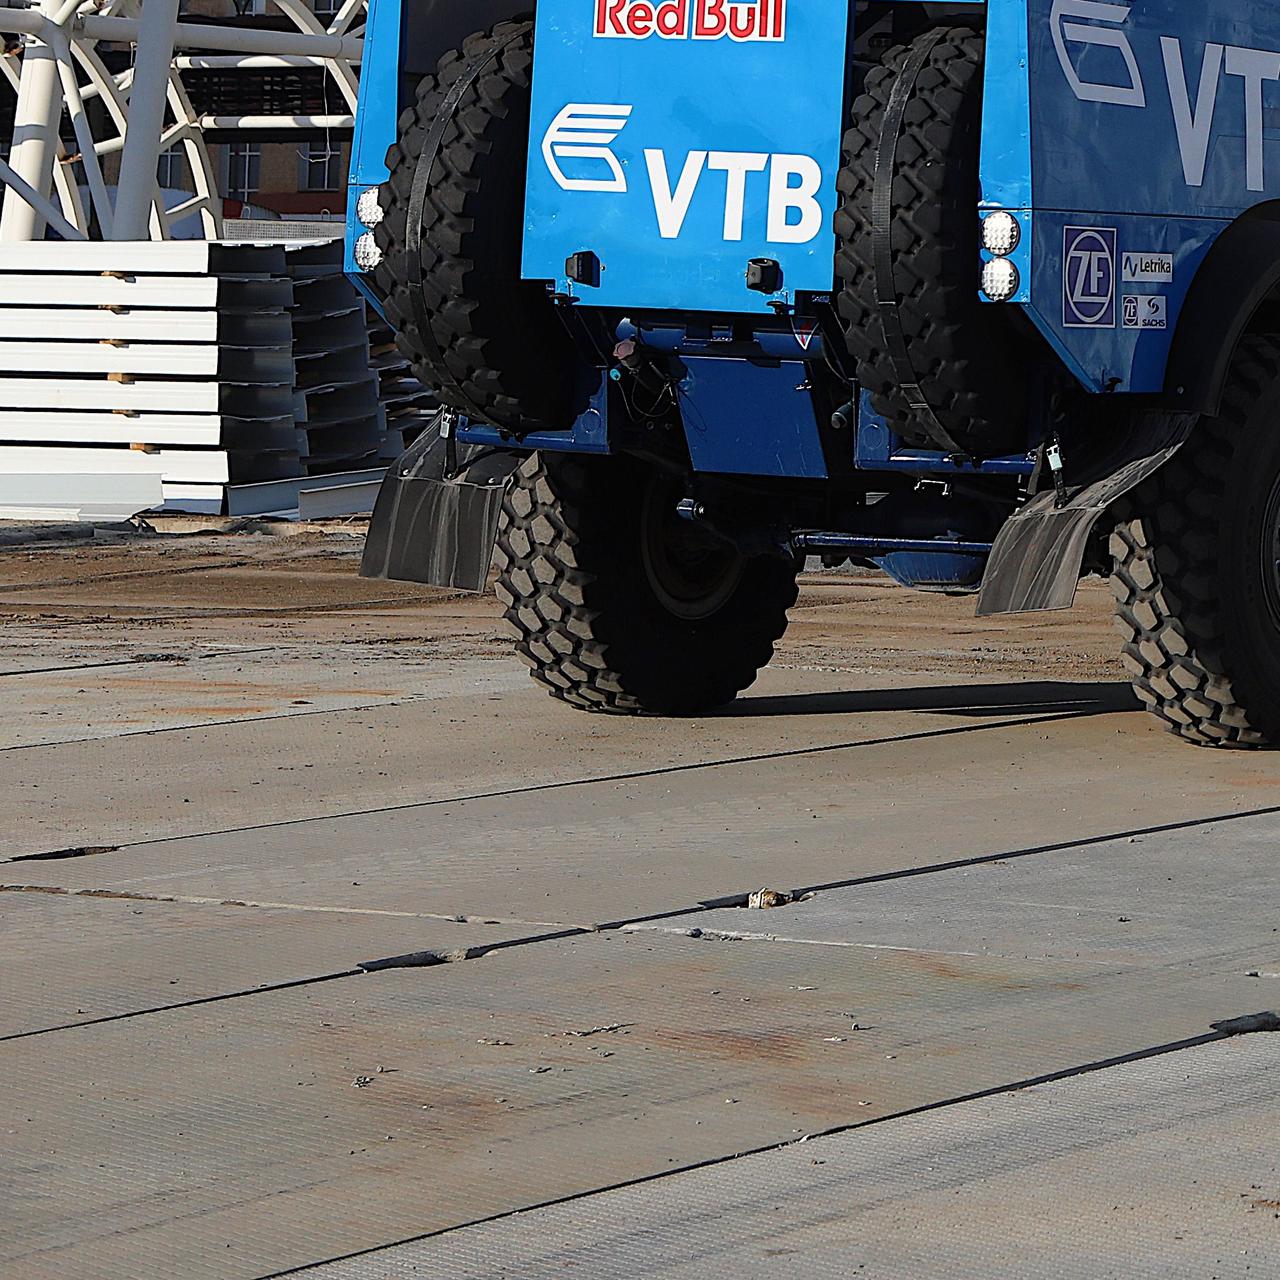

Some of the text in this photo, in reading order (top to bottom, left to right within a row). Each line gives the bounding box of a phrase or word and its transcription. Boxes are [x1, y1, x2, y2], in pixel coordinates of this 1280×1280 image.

[642, 148, 823, 244] VTB
[1139, 257, 1171, 273] Letrika
[1069, 250, 1110, 303] ZF
[1124, 302, 1137, 320] ZF
[1141, 318, 1166, 327] SACHS
